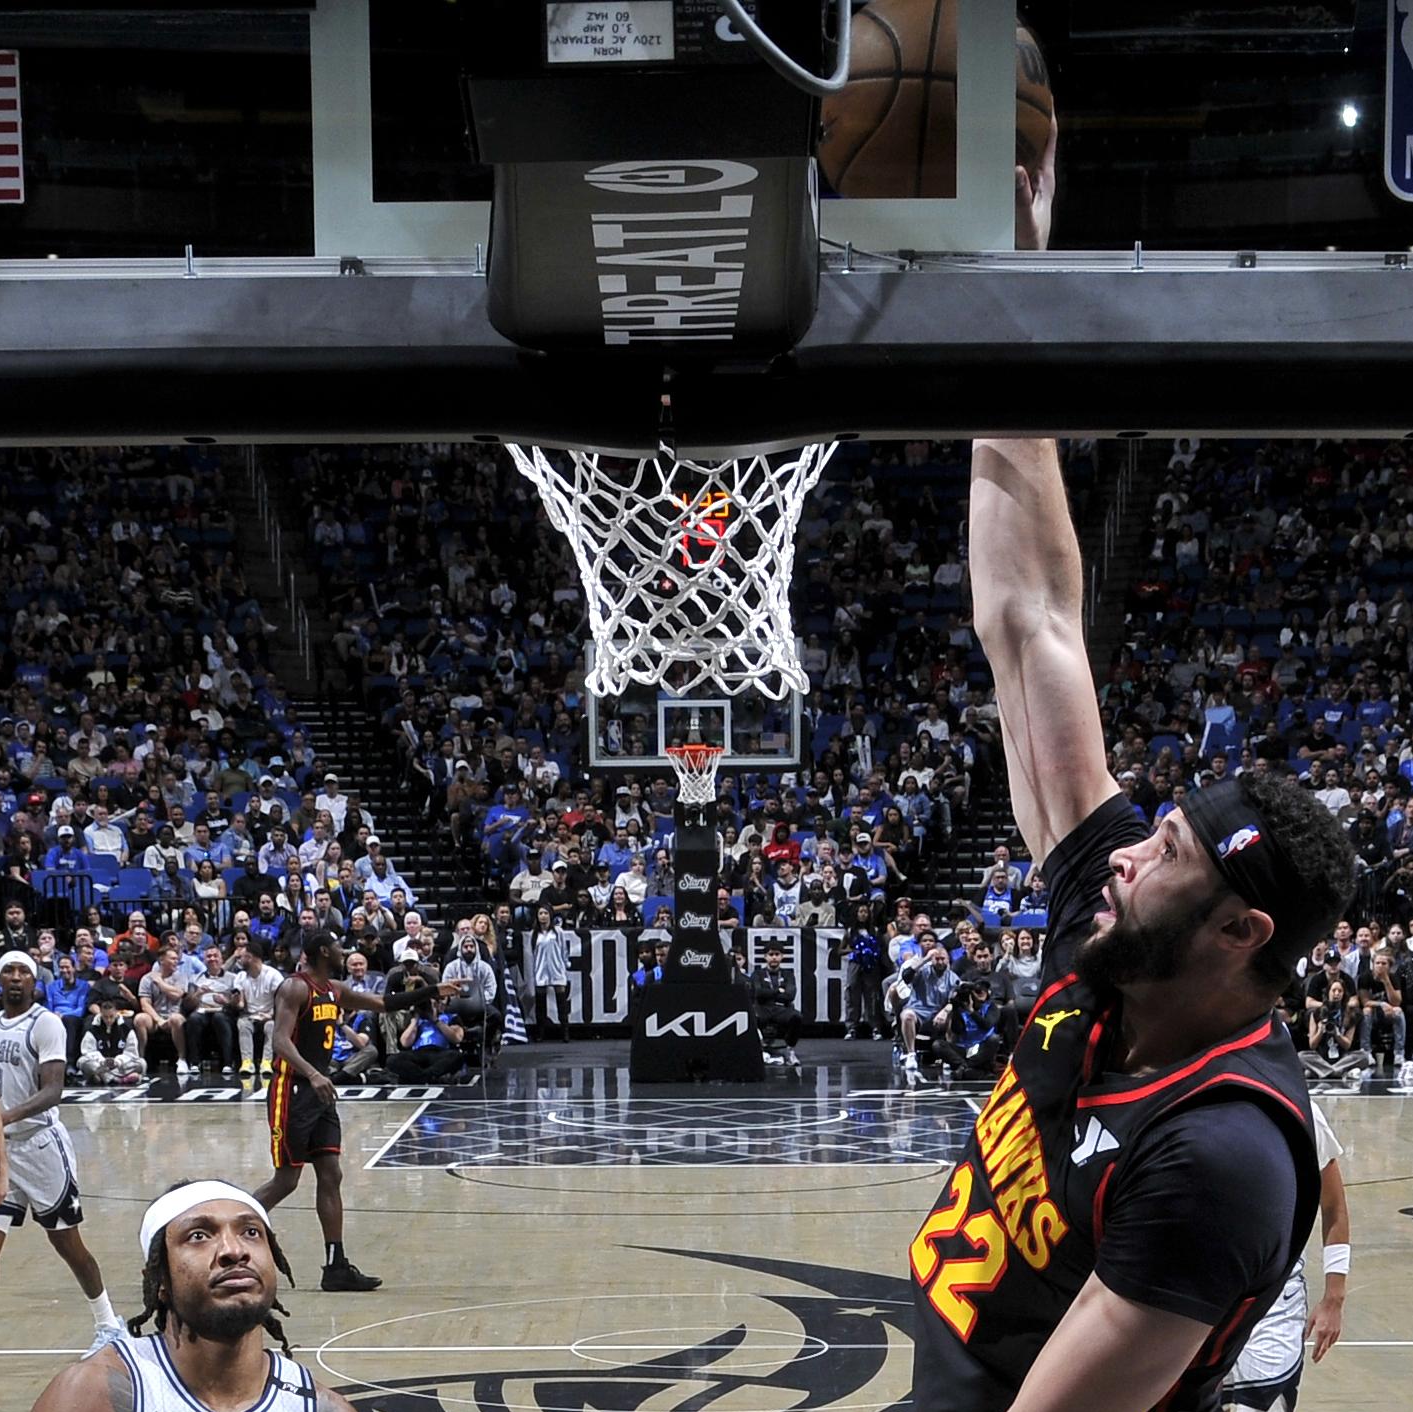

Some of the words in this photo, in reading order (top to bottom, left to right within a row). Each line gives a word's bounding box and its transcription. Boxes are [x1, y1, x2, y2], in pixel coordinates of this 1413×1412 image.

[616, 12, 630, 21] 60
[583, 24, 604, 33] AMP
[612, 24, 632, 33] 3.0
[555, 35, 604, 45] PRIMARY
[611, 36, 626, 45] AC
[633, 35, 661, 45] 120V
[594, 47, 622, 55] HORN
[323, 1026, 334, 1049] 3
[977, 1064, 1069, 1271] HAWKS
[909, 1162, 1007, 1343] 22
